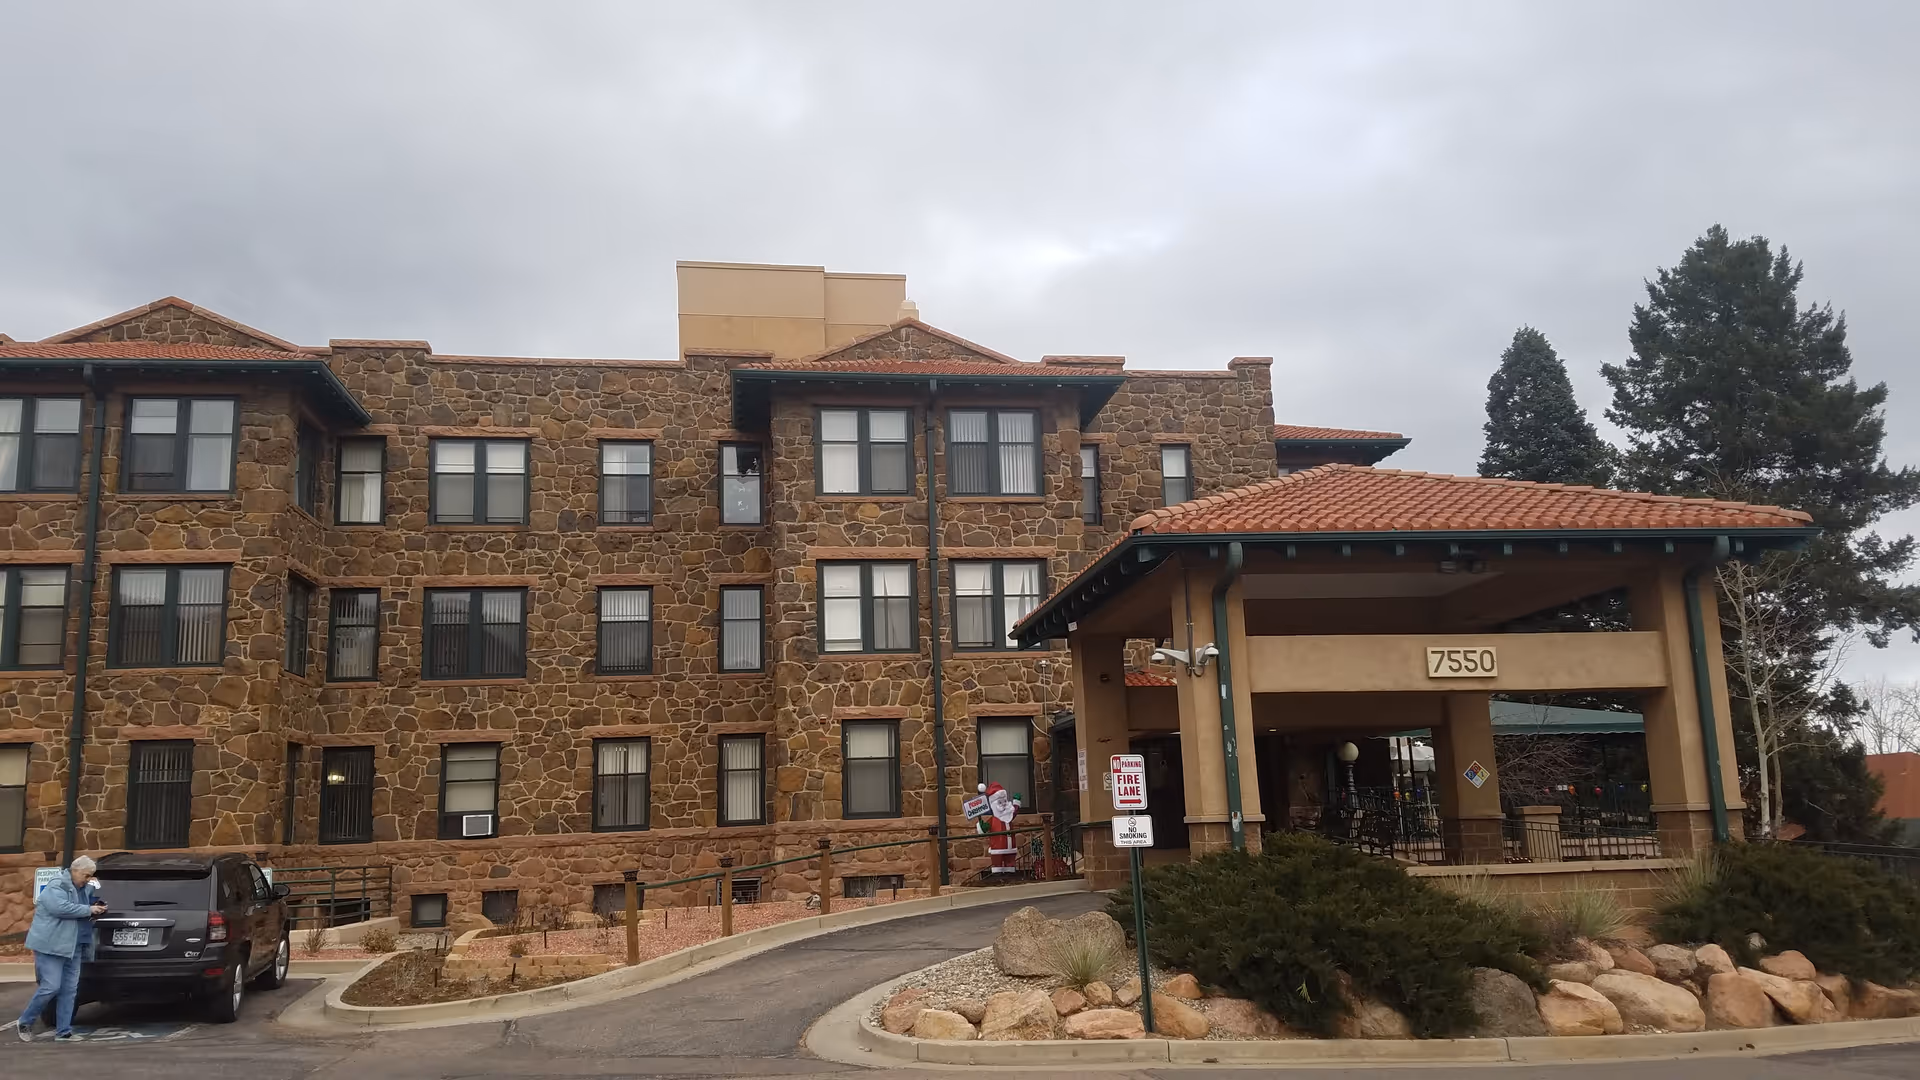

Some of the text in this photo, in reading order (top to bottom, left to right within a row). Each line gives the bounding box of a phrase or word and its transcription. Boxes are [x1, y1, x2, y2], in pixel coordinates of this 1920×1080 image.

[1430, 649, 1495, 673] 7550
[1112, 759, 1121, 769] NO
[1117, 774, 1140, 784] FIRE
[1118, 786, 1141, 796] LANE
